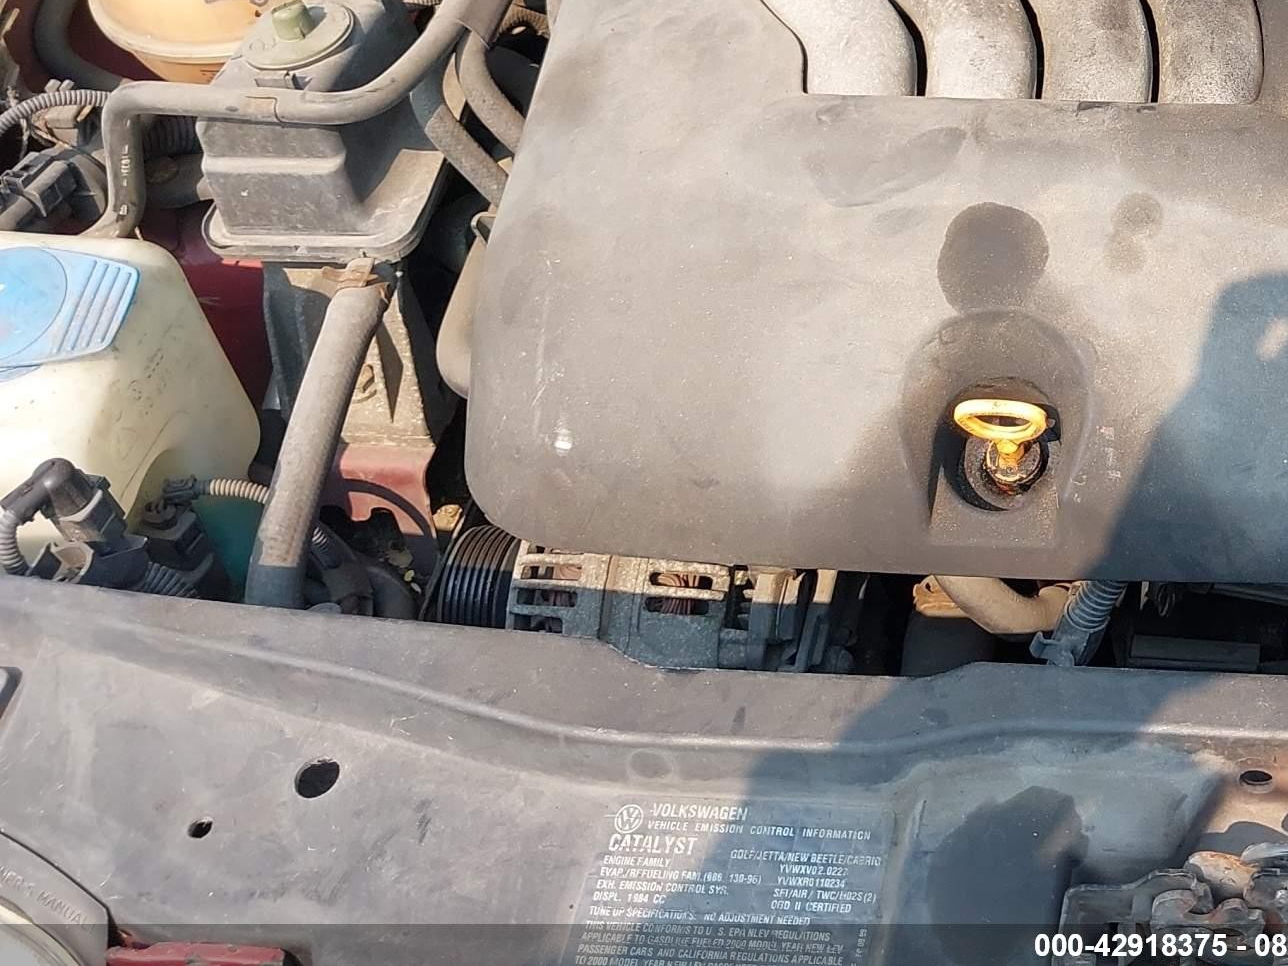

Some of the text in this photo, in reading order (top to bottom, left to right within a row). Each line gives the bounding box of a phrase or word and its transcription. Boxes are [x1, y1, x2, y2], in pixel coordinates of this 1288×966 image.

[651, 803, 748, 821] VOLKSWAGEN
[647, 820, 871, 841] VEHICLE EMISSION CONTROL INFORMATION
[608, 833, 698, 855] CATALYST
[603, 854, 671, 867] ENGINE FAMILY
[596, 879, 617, 889] EXH.
[619, 881, 662, 892] EMISSION
[665, 883, 706, 894] CONTROL
[592, 891, 667, 904] DISPL. 1984 CC
[589, 905, 612, 916] TUNE
[612, 907, 625, 917] UP
[703, 912, 717, 921] NO
[718, 913, 775, 924] ADJUSTMENT
[776, 915, 811, 925] NEEDED
[805, 902, 851, 913] CERTIFIED
[585, 920, 604, 931] THIS
[606, 921, 641, 932] VEHICLE
[642, 922, 690, 934] CONFORMS
[693, 925, 705, 935] TO
[728, 927, 746, 937] EPA
[771, 928, 831, 942] REGULATIONS
[580, 931, 633, 944] APPLICABLE
[633, 934, 646, 944] TO
[781, 941, 803, 952] YEAR
[804, 943, 825, 953] NEW
[575, 955, 587, 965] TO
[587, 956, 608, 966] 2000
[577, 943, 628, 955] PASSENGER
[629, 946, 653, 956] CARS
[656, 948, 675, 958] AND
[677, 948, 728, 960] CALIFORNIA
[729, 950, 791, 963] REGULATIONS
[791, 954, 844, 966] APPLICABLE
